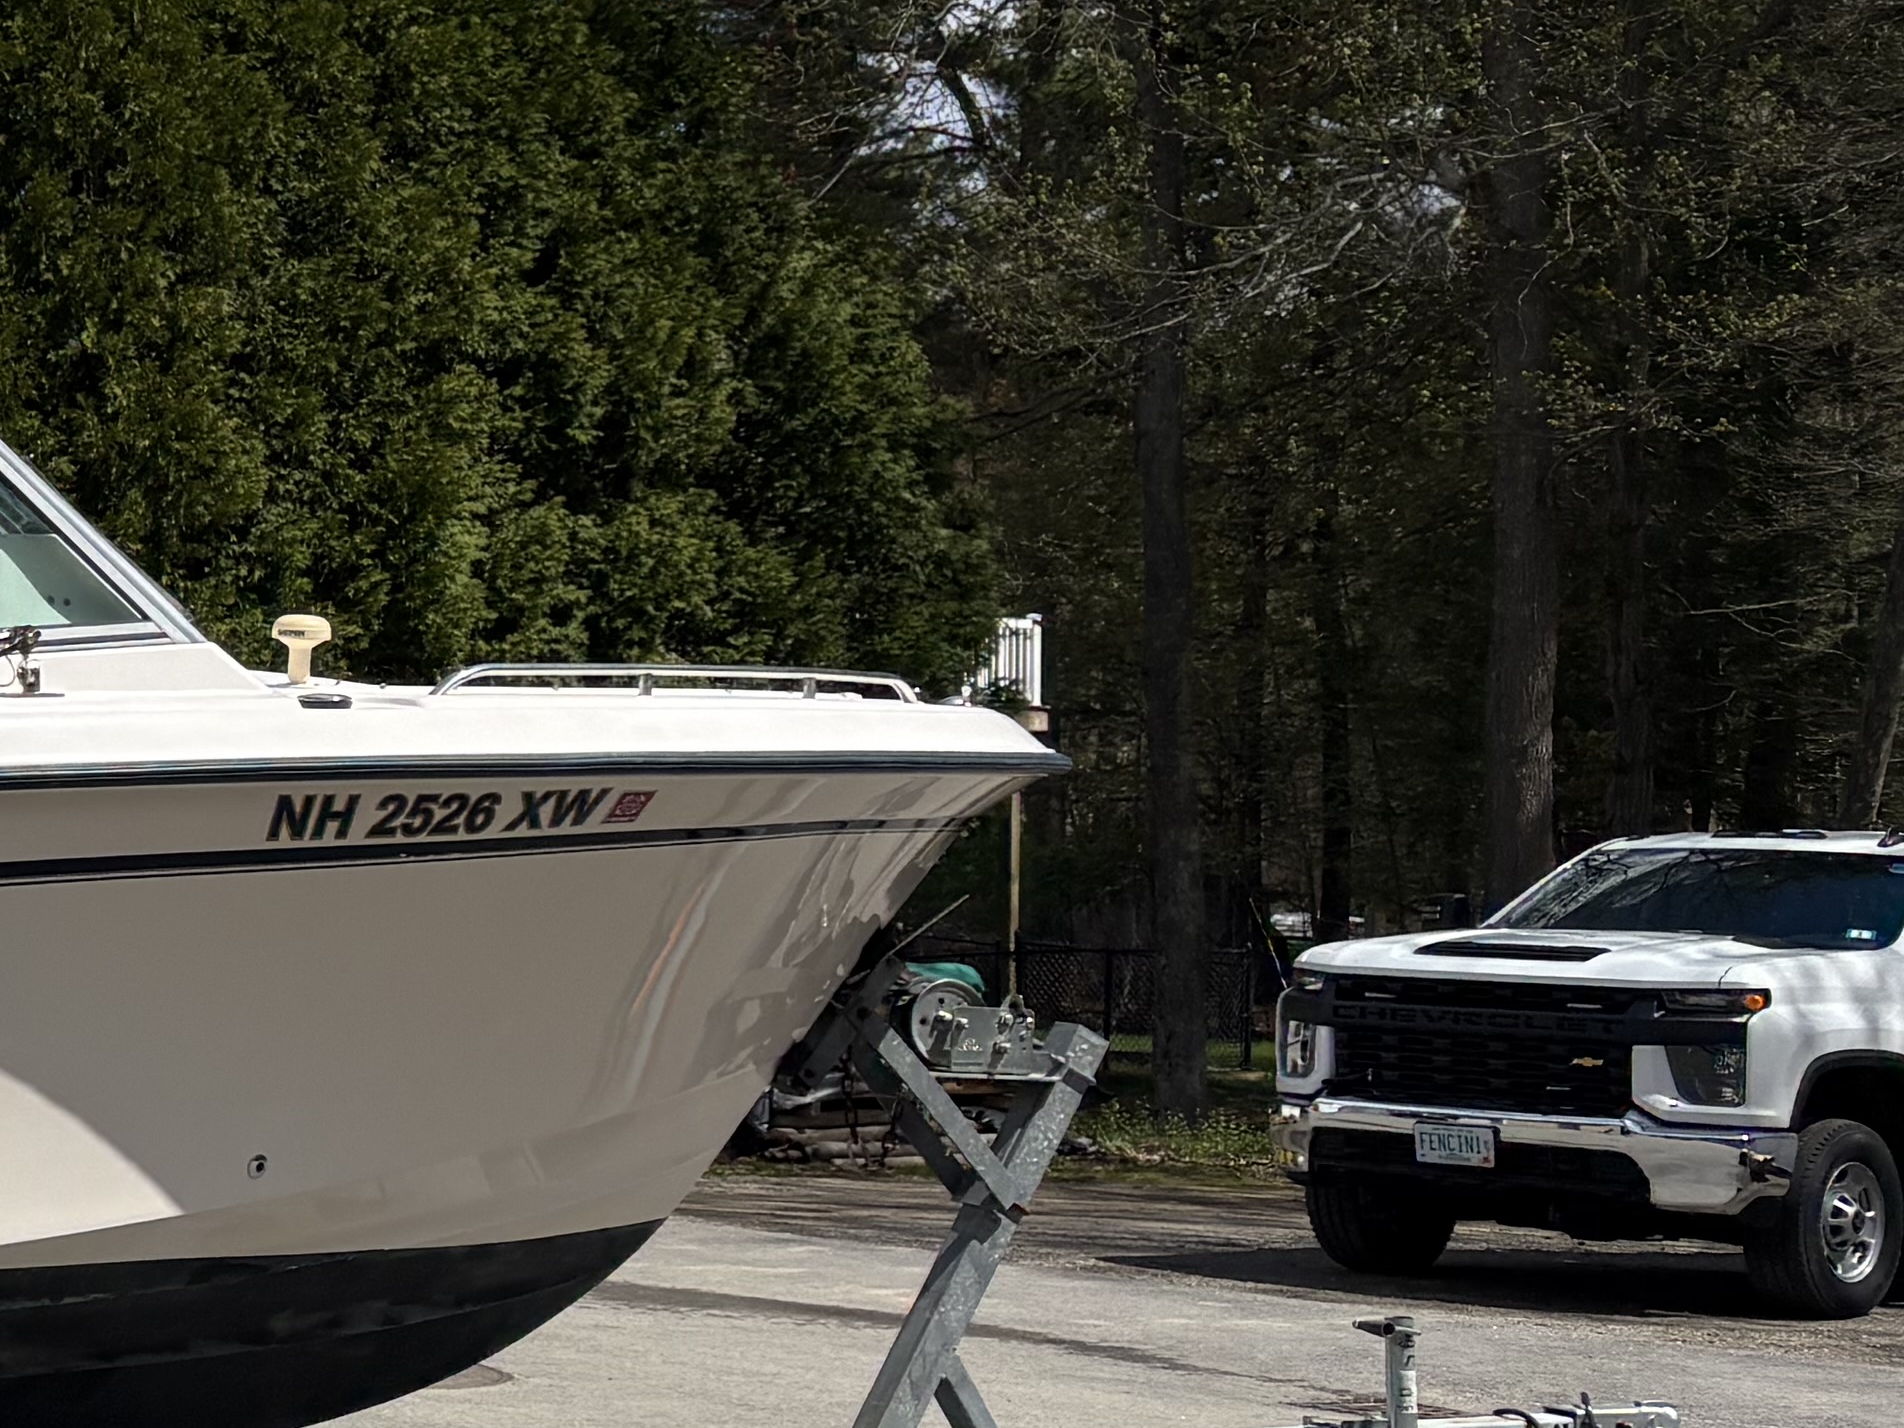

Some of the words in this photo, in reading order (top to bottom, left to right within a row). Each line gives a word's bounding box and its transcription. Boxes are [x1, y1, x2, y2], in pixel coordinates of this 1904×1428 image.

[266, 794, 361, 841] NH
[364, 792, 502, 839] 2526
[499, 787, 614, 833] XW
